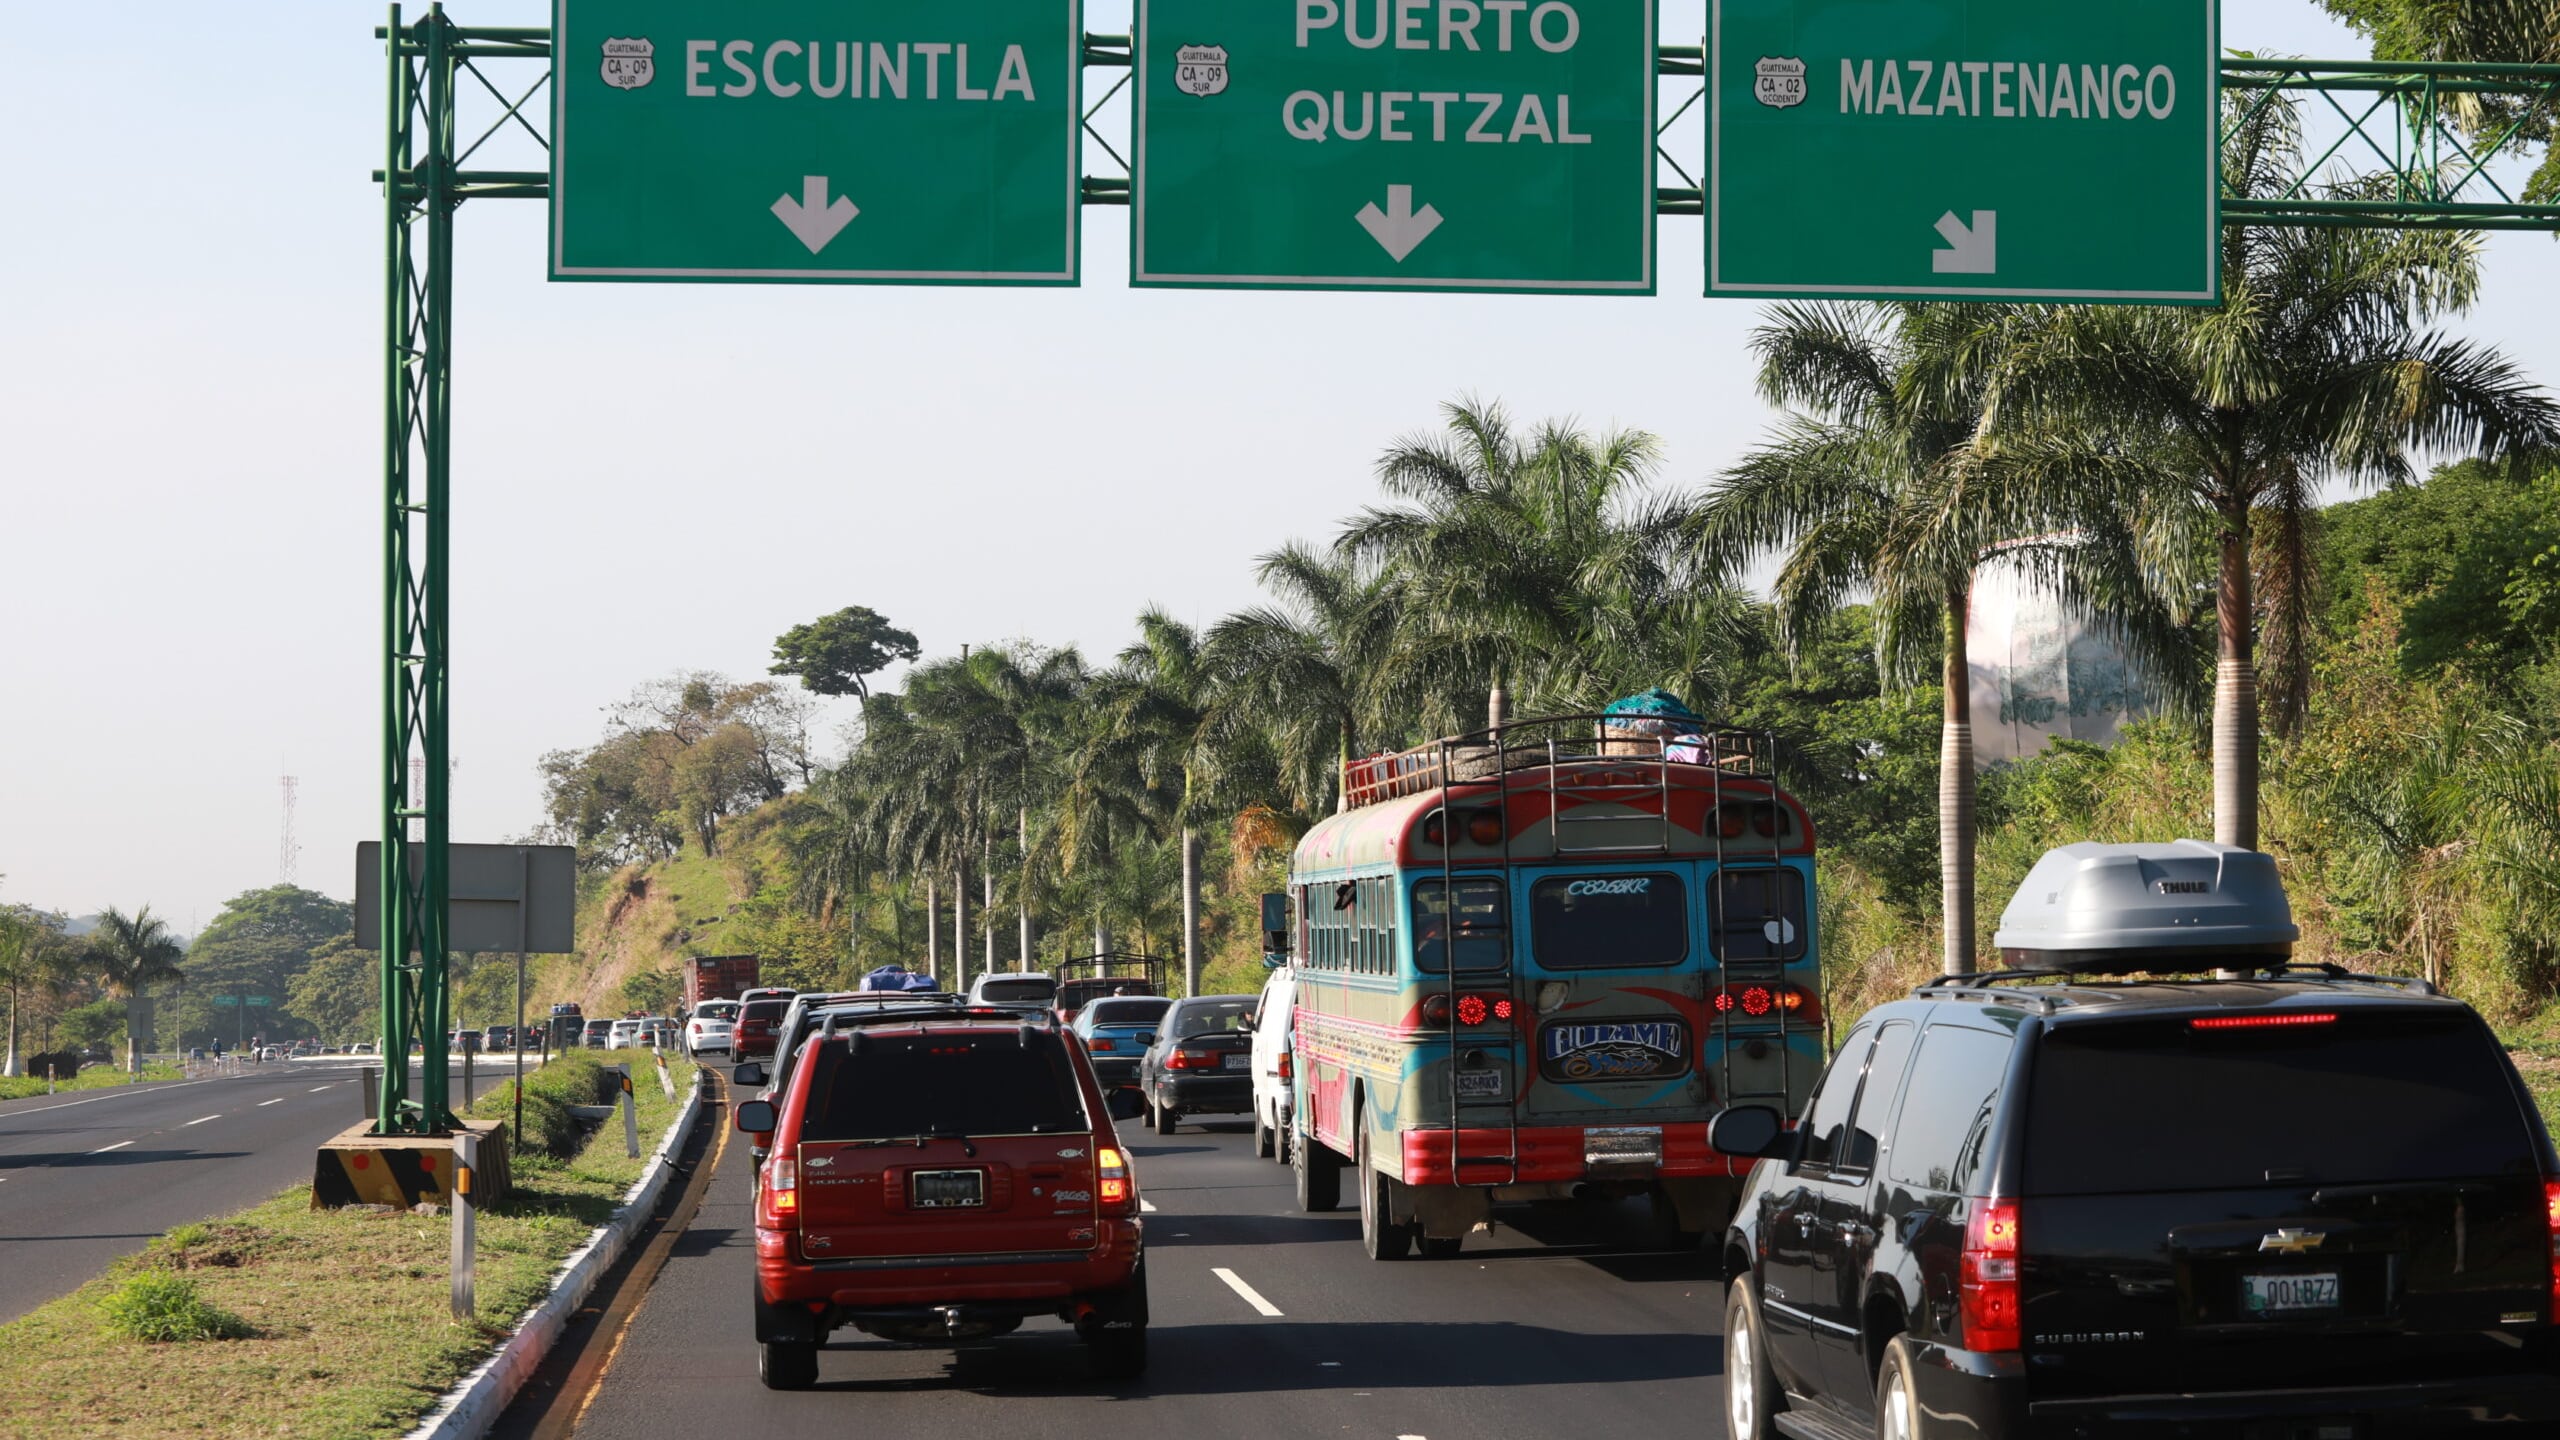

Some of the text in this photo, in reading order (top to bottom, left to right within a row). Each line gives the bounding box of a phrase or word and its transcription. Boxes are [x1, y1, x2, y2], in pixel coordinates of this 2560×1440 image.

[1296, 0, 1580, 53] PUERTO
[608, 43, 648, 53] GUATEMALA
[1182, 51, 1221, 61] GUATEMALA
[608, 59, 622, 74] CA
[633, 59, 647, 74] 09
[686, 39, 1036, 101] ESCUINTLA
[1761, 63, 1800, 73] GUATEMALA
[618, 75, 636, 85] SUR
[1182, 66, 1197, 81] CA
[1207, 67, 1222, 82] 09
[1193, 82, 1210, 92] SUR
[1761, 77, 1775, 92] CA
[1786, 78, 1800, 93] 02
[1840, 58, 2177, 120] MAZATENANGO
[1763, 94, 1798, 103] OCCIDENTE
[1282, 89, 1593, 144] QUETZAL
[2160, 882, 2208, 894] THULE
[2034, 1331, 2145, 1345] SUBURBAN
